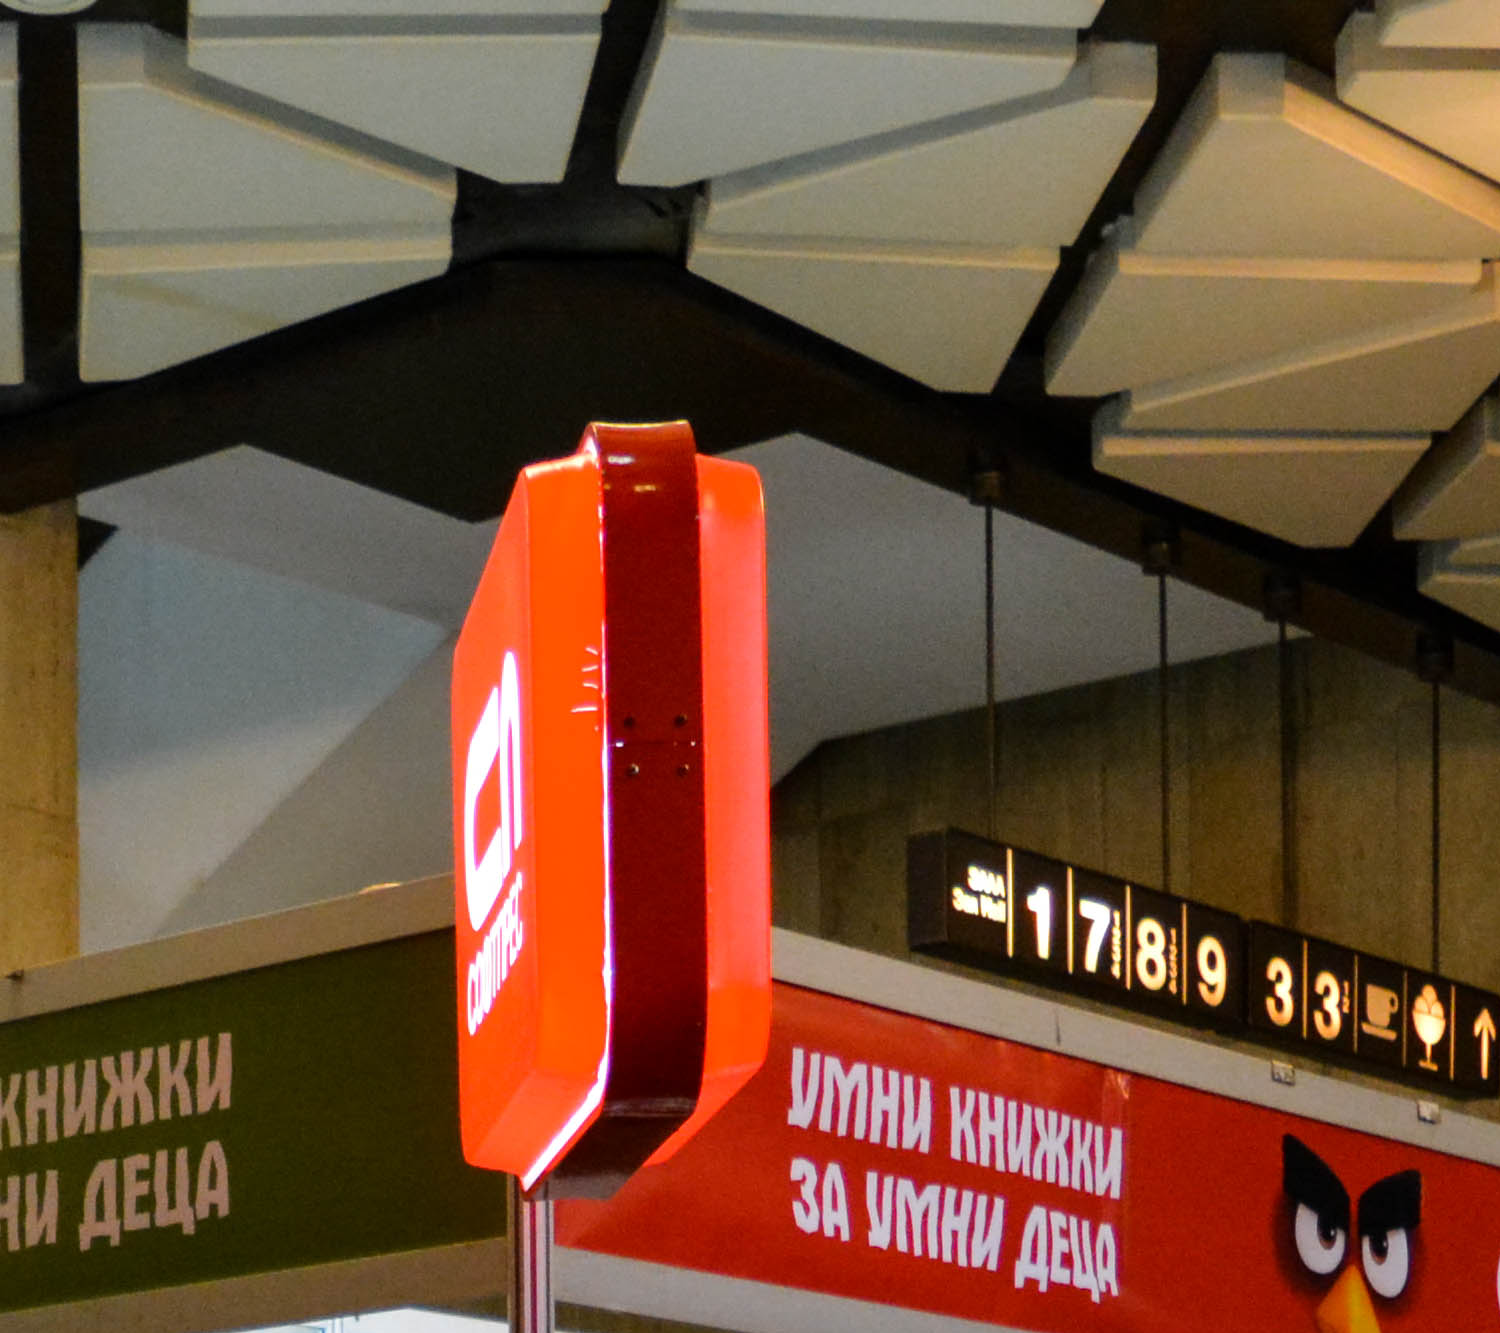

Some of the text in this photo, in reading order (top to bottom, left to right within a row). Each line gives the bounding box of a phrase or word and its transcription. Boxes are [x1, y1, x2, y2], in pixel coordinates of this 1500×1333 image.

[1027, 886, 1050, 960] 1
[1079, 899, 1110, 973] 7
[1136, 917, 1167, 991] 8
[1197, 935, 1227, 1006] 9
[1266, 956, 1294, 1026] 3
[788, 1047, 1123, 1200] УМНИ КНИЖКИ
[79, 1140, 230, 1252] ДЕЦА
[790, 1157, 1120, 1304] ЗА УМНИ ДЕЦА
